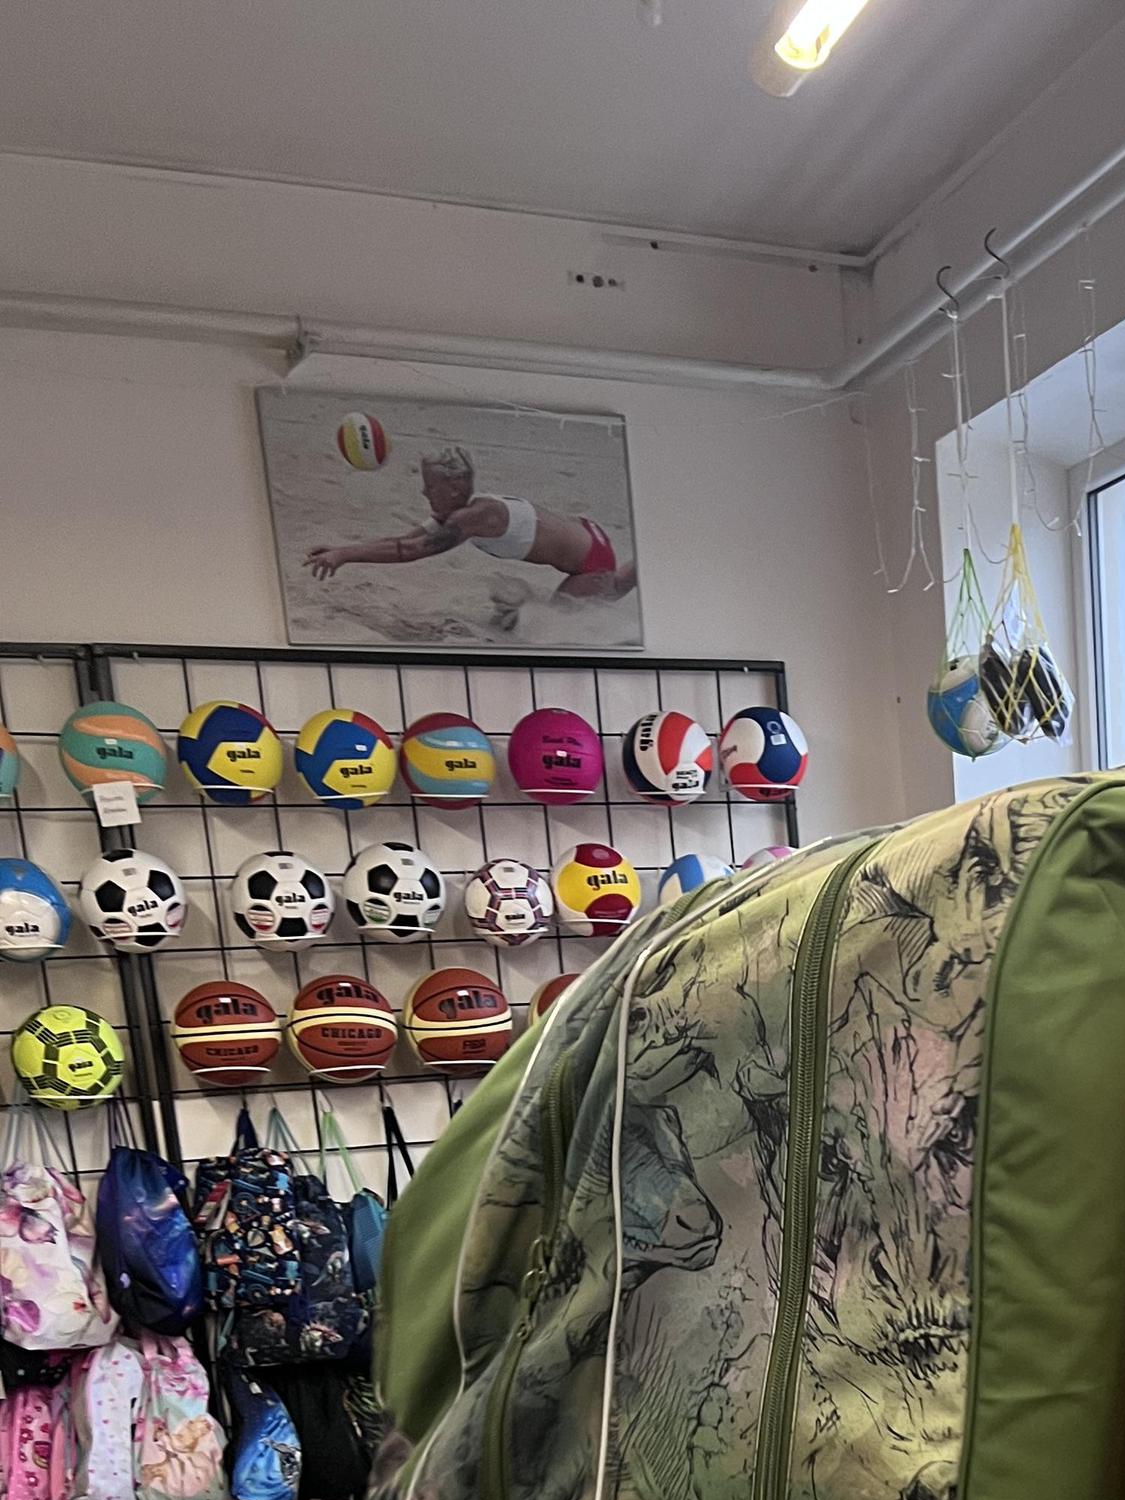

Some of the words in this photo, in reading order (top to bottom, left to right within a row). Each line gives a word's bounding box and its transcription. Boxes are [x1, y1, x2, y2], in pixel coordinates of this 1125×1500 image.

[639, 714, 658, 751] gala
[96, 746, 134, 759] gala
[226, 747, 261, 762] gala
[445, 758, 477, 771] gala
[542, 752, 581, 769] gala
[339, 765, 373, 778] gala
[586, 870, 628, 891] gala
[275, 892, 306, 906] gala
[392, 891, 424, 903] gala
[127, 899, 159, 917] gala
[504, 912, 526, 922] gala
[5, 922, 40, 936] gala
[316, 984, 380, 1006] gala
[195, 998, 258, 1025] gala
[438, 990, 498, 1019] gala
[321, 1027, 383, 1039] CHICAGO
[206, 1045, 259, 1056] CHICAGO
